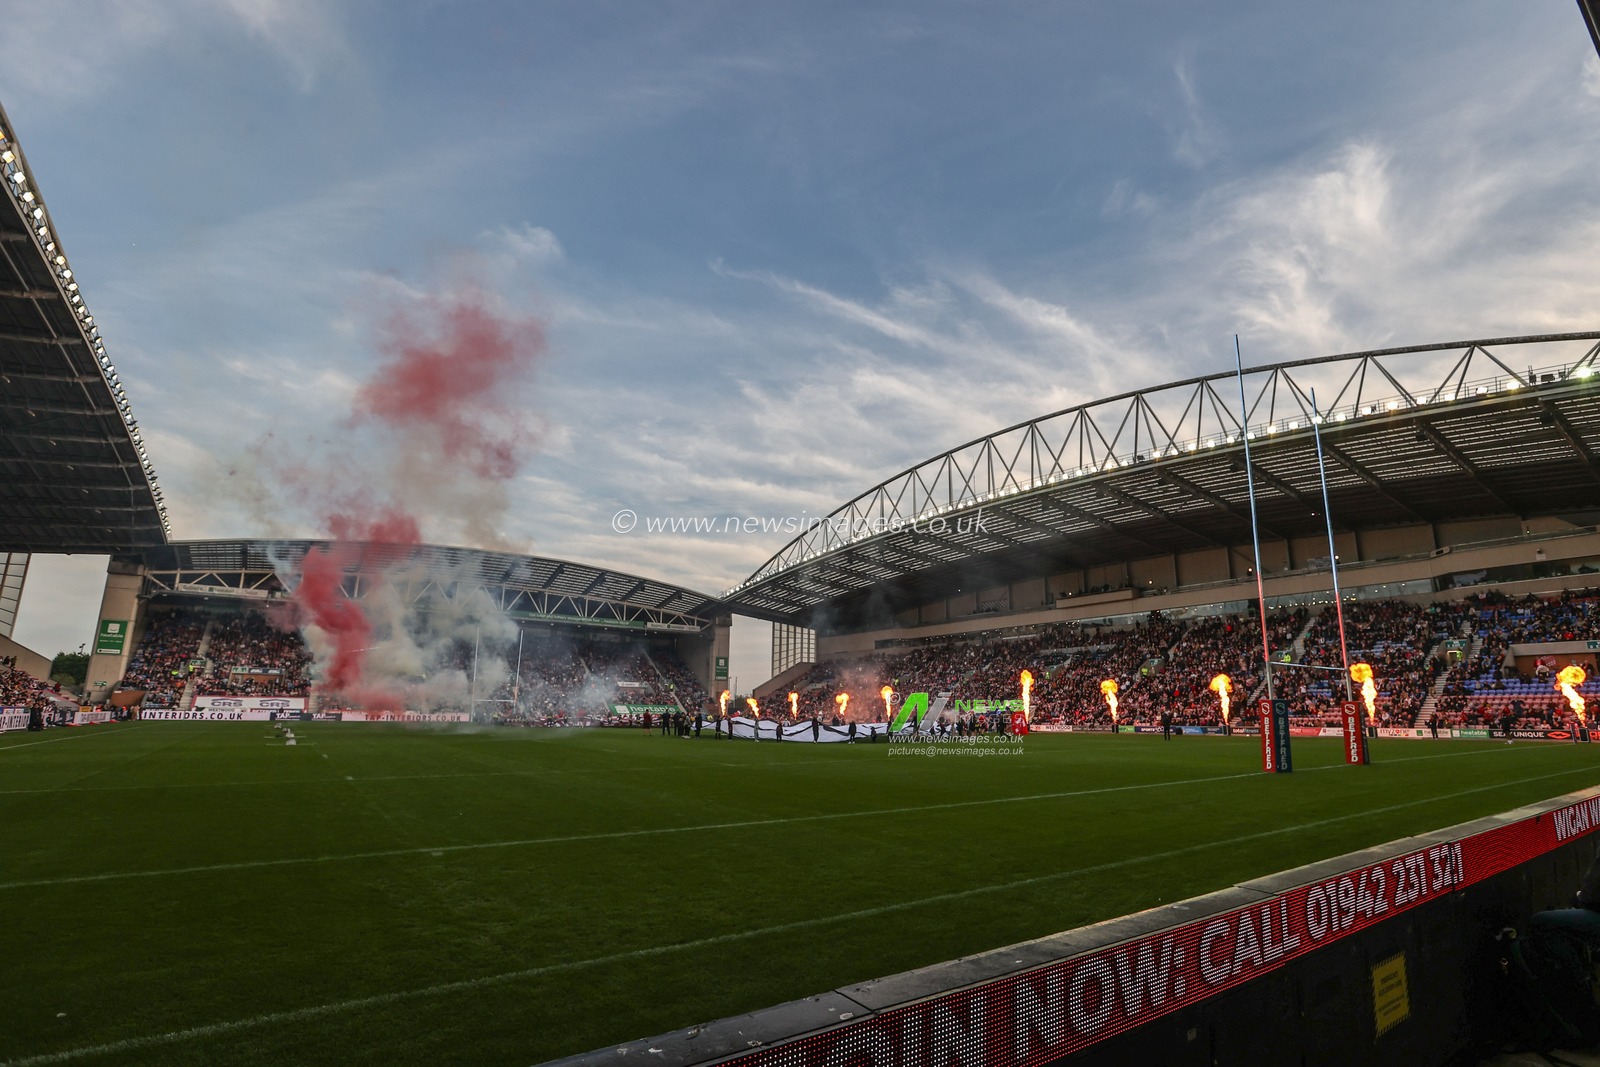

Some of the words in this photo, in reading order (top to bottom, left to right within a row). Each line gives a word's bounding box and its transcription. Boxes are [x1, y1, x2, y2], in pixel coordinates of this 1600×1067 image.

[143, 711, 243, 720] INTERIORS.CO.UK
[1347, 716, 1359, 763] BETFRED
[1263, 717, 1272, 769] BETFRED
[1278, 717, 1288, 770] BETFRED
[1553, 801, 1590, 841] WIGAN
[1016, 934, 1186, 1059] NOW:
[1201, 896, 1301, 984] CALL
[1306, 867, 1389, 940] 01942
[1391, 853, 1428, 906] 231
